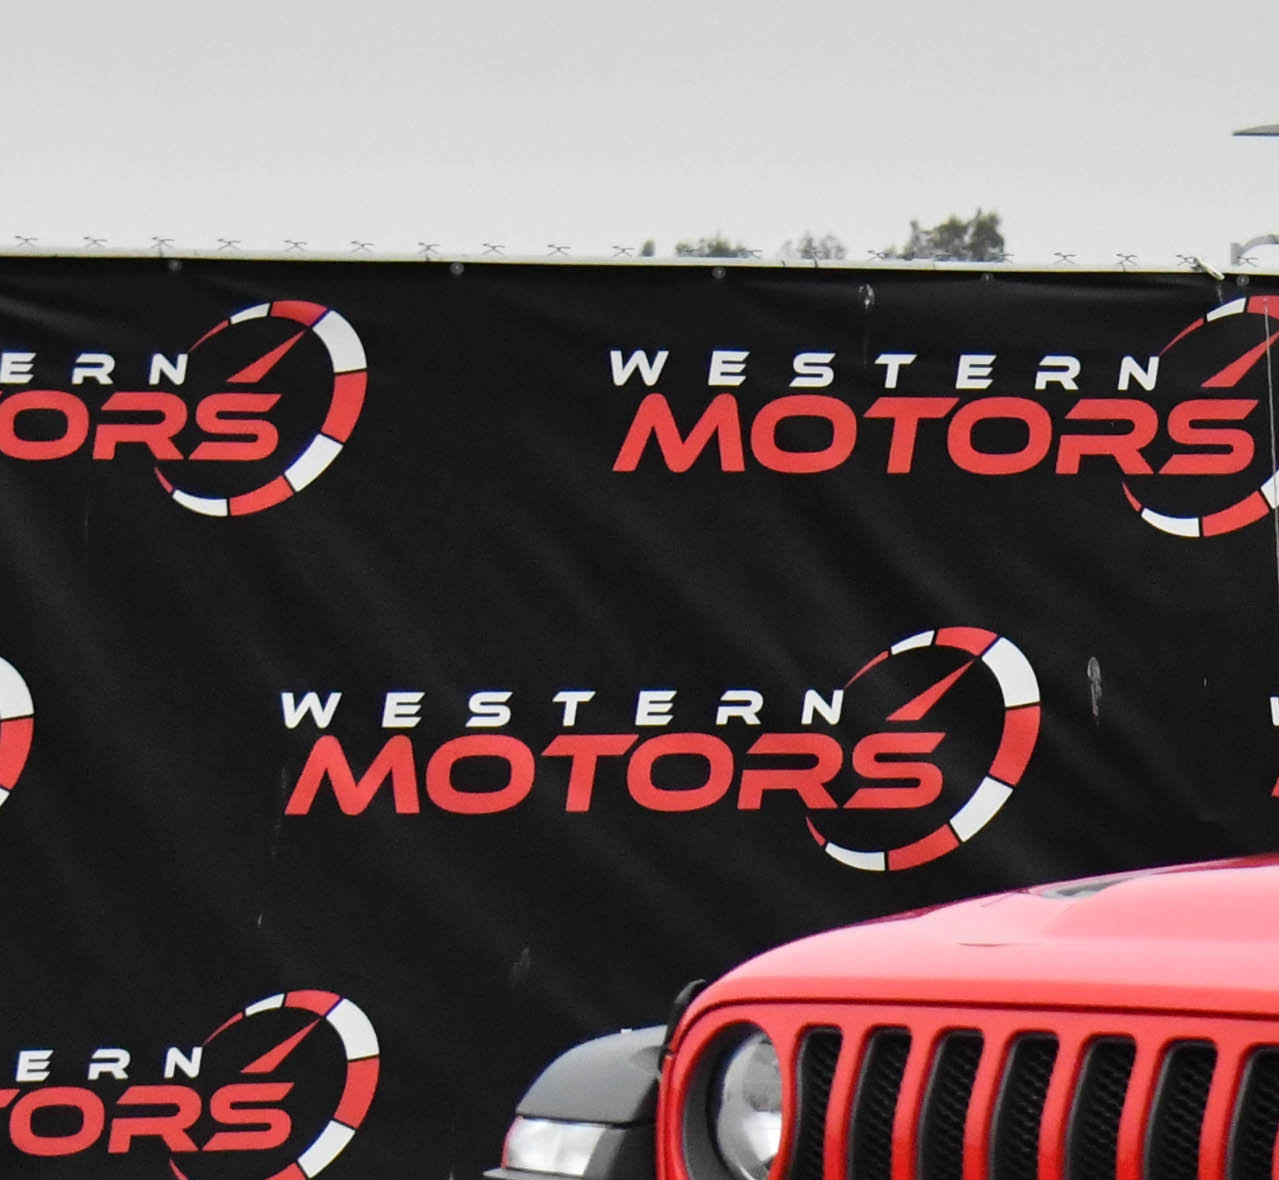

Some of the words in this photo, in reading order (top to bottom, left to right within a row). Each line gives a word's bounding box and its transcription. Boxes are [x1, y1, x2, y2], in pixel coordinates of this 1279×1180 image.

[611, 350, 1159, 391] WESTERN
[613, 393, 1258, 475] MOTORS
[281, 690, 844, 729] WESTERN
[284, 732, 946, 816] MOTORS
